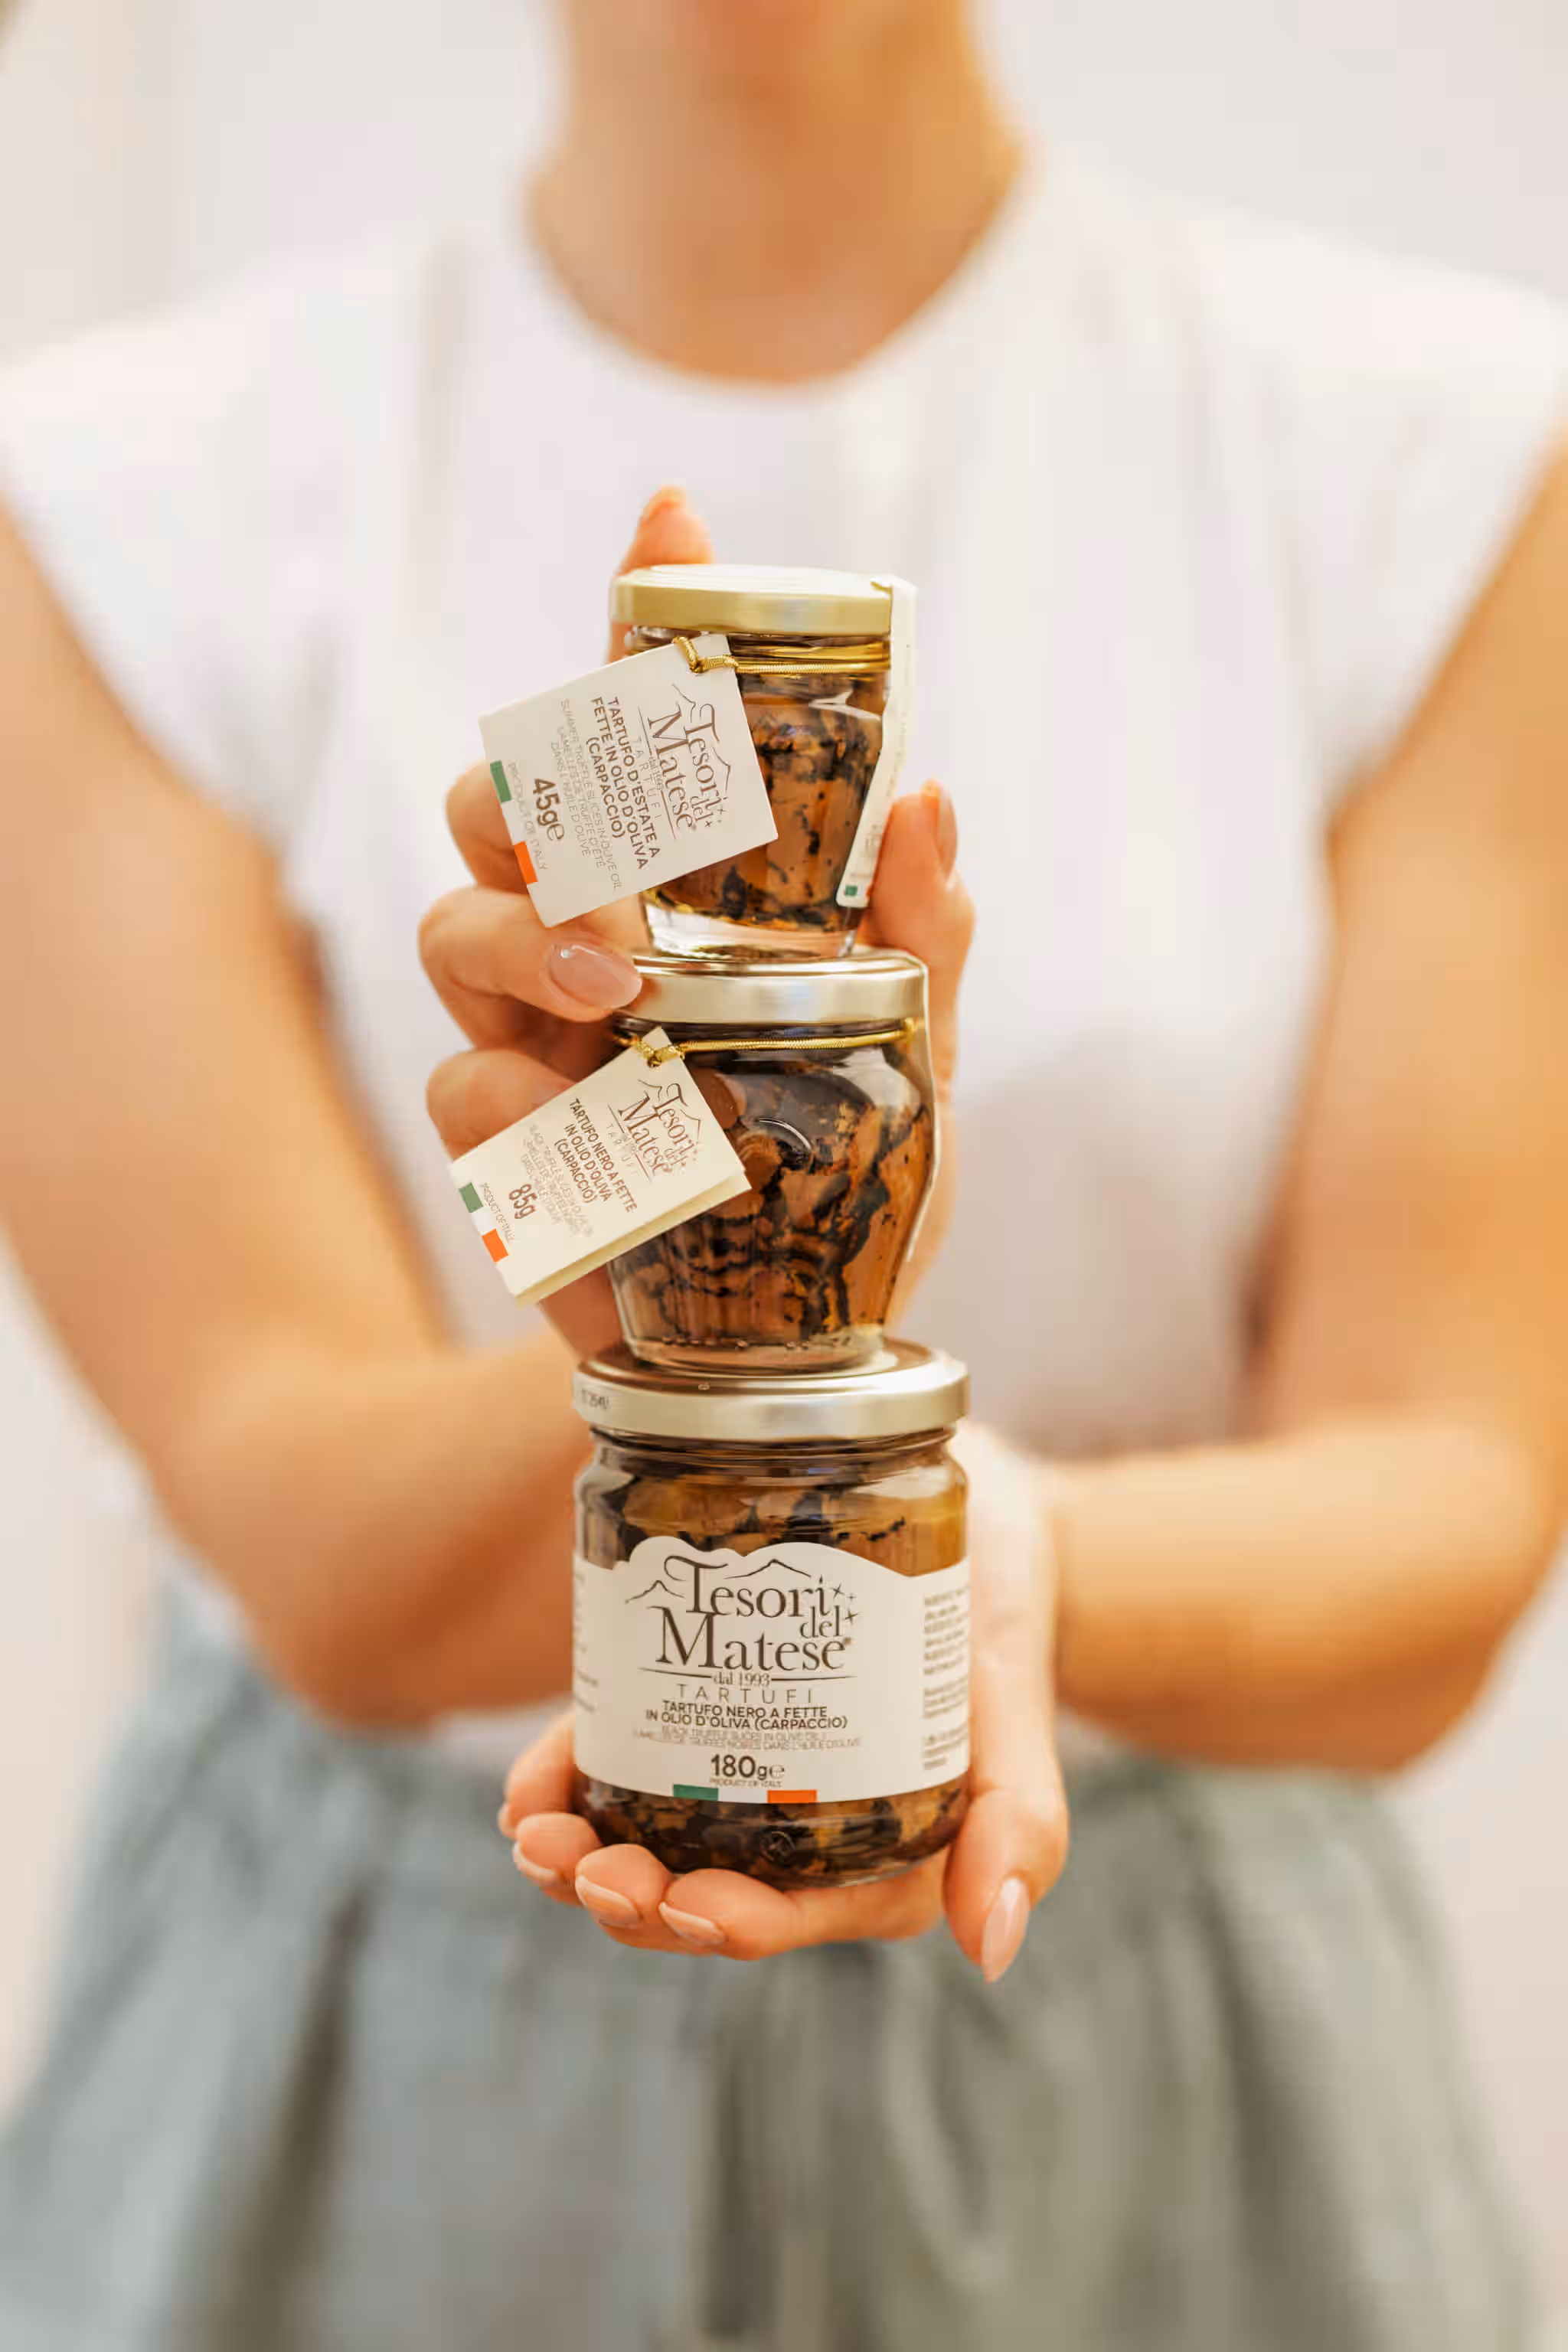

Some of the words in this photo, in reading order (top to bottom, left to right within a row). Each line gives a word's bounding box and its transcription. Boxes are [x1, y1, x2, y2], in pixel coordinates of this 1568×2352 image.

[590, 696, 614, 743] FETTE
[603, 744, 619, 763] IN
[683, 704, 728, 809] Tesori
[583, 735, 626, 840] (CARPACCIO)
[606, 696, 636, 768] TARTUFO
[626, 769, 658, 844] D'ESTATE
[648, 844, 662, 859] A
[609, 763, 629, 803] OLIO
[630, 736, 663, 818] TARTUFI
[689, 795, 714, 822] del
[570, 812, 590, 857] D'OLIVE
[596, 826, 607, 839] IN
[620, 805, 650, 870] D'OLIVA
[599, 837, 617, 872] OLIVE
[609, 871, 622, 891] OIL
[563, 1122, 578, 1136] IN
[567, 1097, 599, 1144] TARTUFO
[652, 1083, 697, 1155] Tesori
[570, 1134, 592, 1162] OLIO
[591, 1141, 616, 1172] NERO
[553, 1137, 598, 1205] (CARPACCIO)
[583, 1159, 614, 1202] D'OLIVA
[606, 1169, 620, 1181] A
[508, 1184, 537, 1219] 85g
[612, 1178, 638, 1213] FETTE
[495, 1212, 507, 1225] OF
[664, 1555, 831, 1619] Tesori
[799, 1606, 843, 1639] del
[677, 1683, 812, 1704] TARTUFI
[713, 1671, 733, 1685] dal
[739, 1673, 770, 1687] 1993
[646, 1709, 658, 1722] IN
[662, 1711, 692, 1725] OLIO
[695, 1715, 751, 1729] D'OLIVA
[755, 1716, 848, 1730] (CARPACCIO)
[663, 1700, 723, 1717] TARTUFO
[727, 1705, 766, 1719] NERO
[770, 1707, 779, 1718] A
[784, 1706, 828, 1718] FETTE
